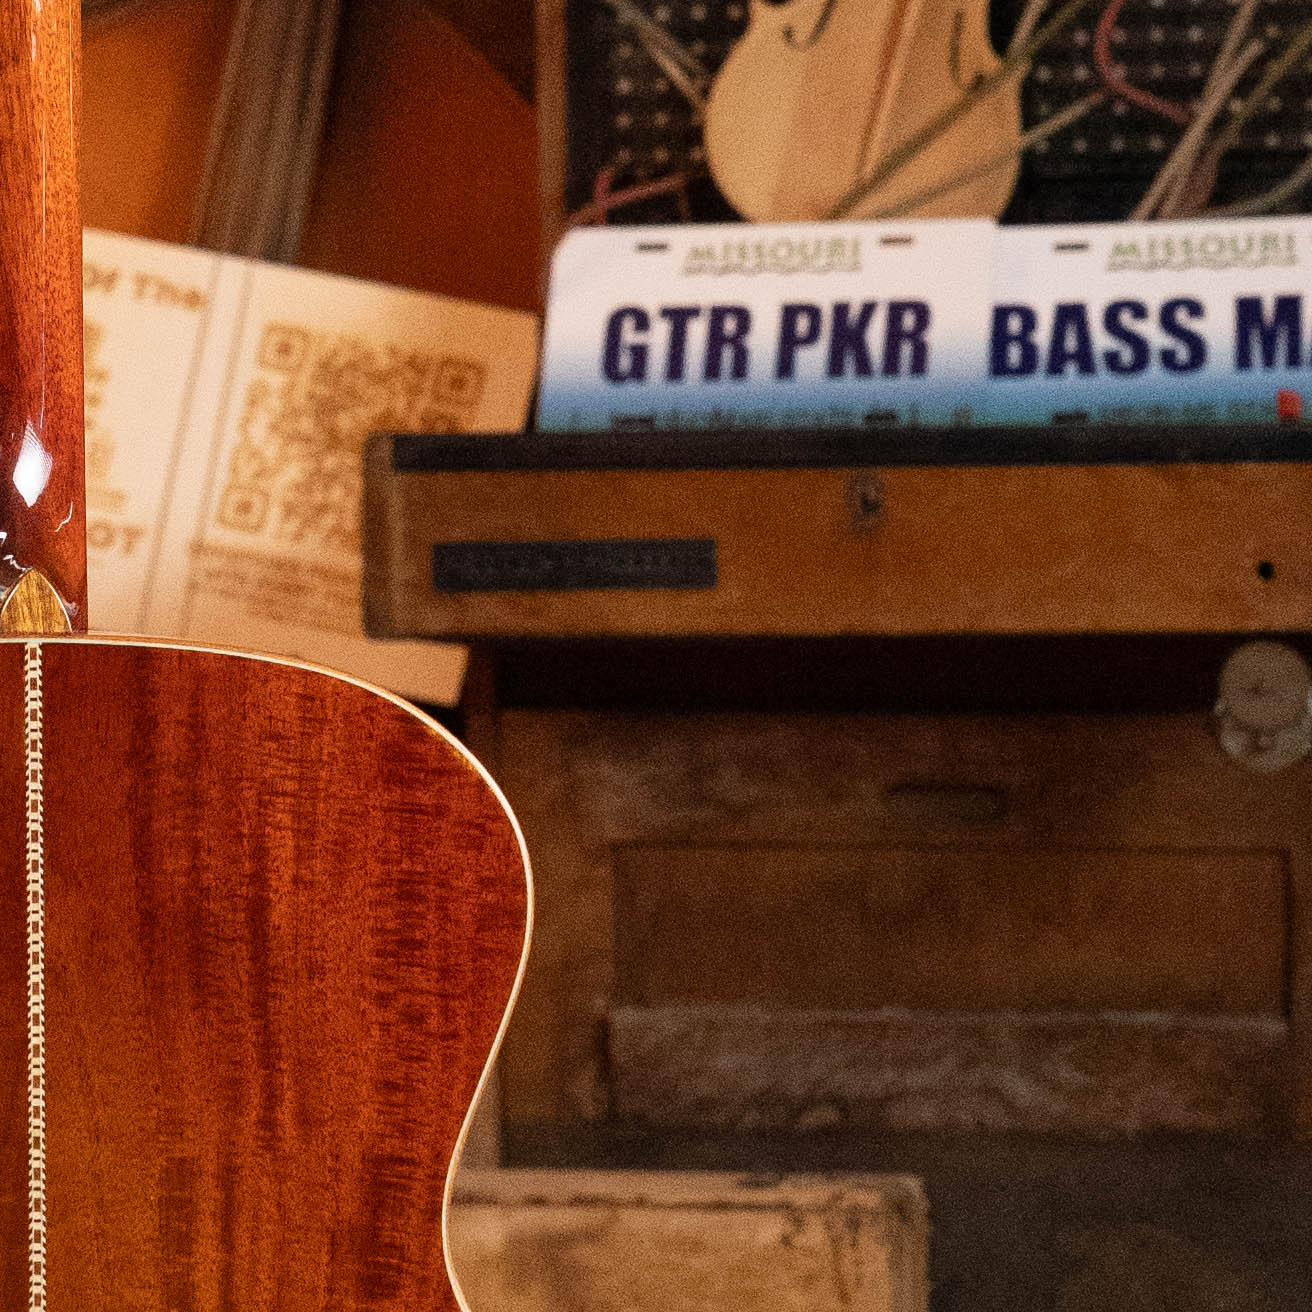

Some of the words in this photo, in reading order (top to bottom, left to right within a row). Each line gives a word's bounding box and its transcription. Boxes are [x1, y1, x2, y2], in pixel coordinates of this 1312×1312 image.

[601, 304, 752, 384] GTR
[775, 300, 932, 379] PKR
[989, 296, 1209, 378] BASS
[1234, 294, 1312, 372] M
